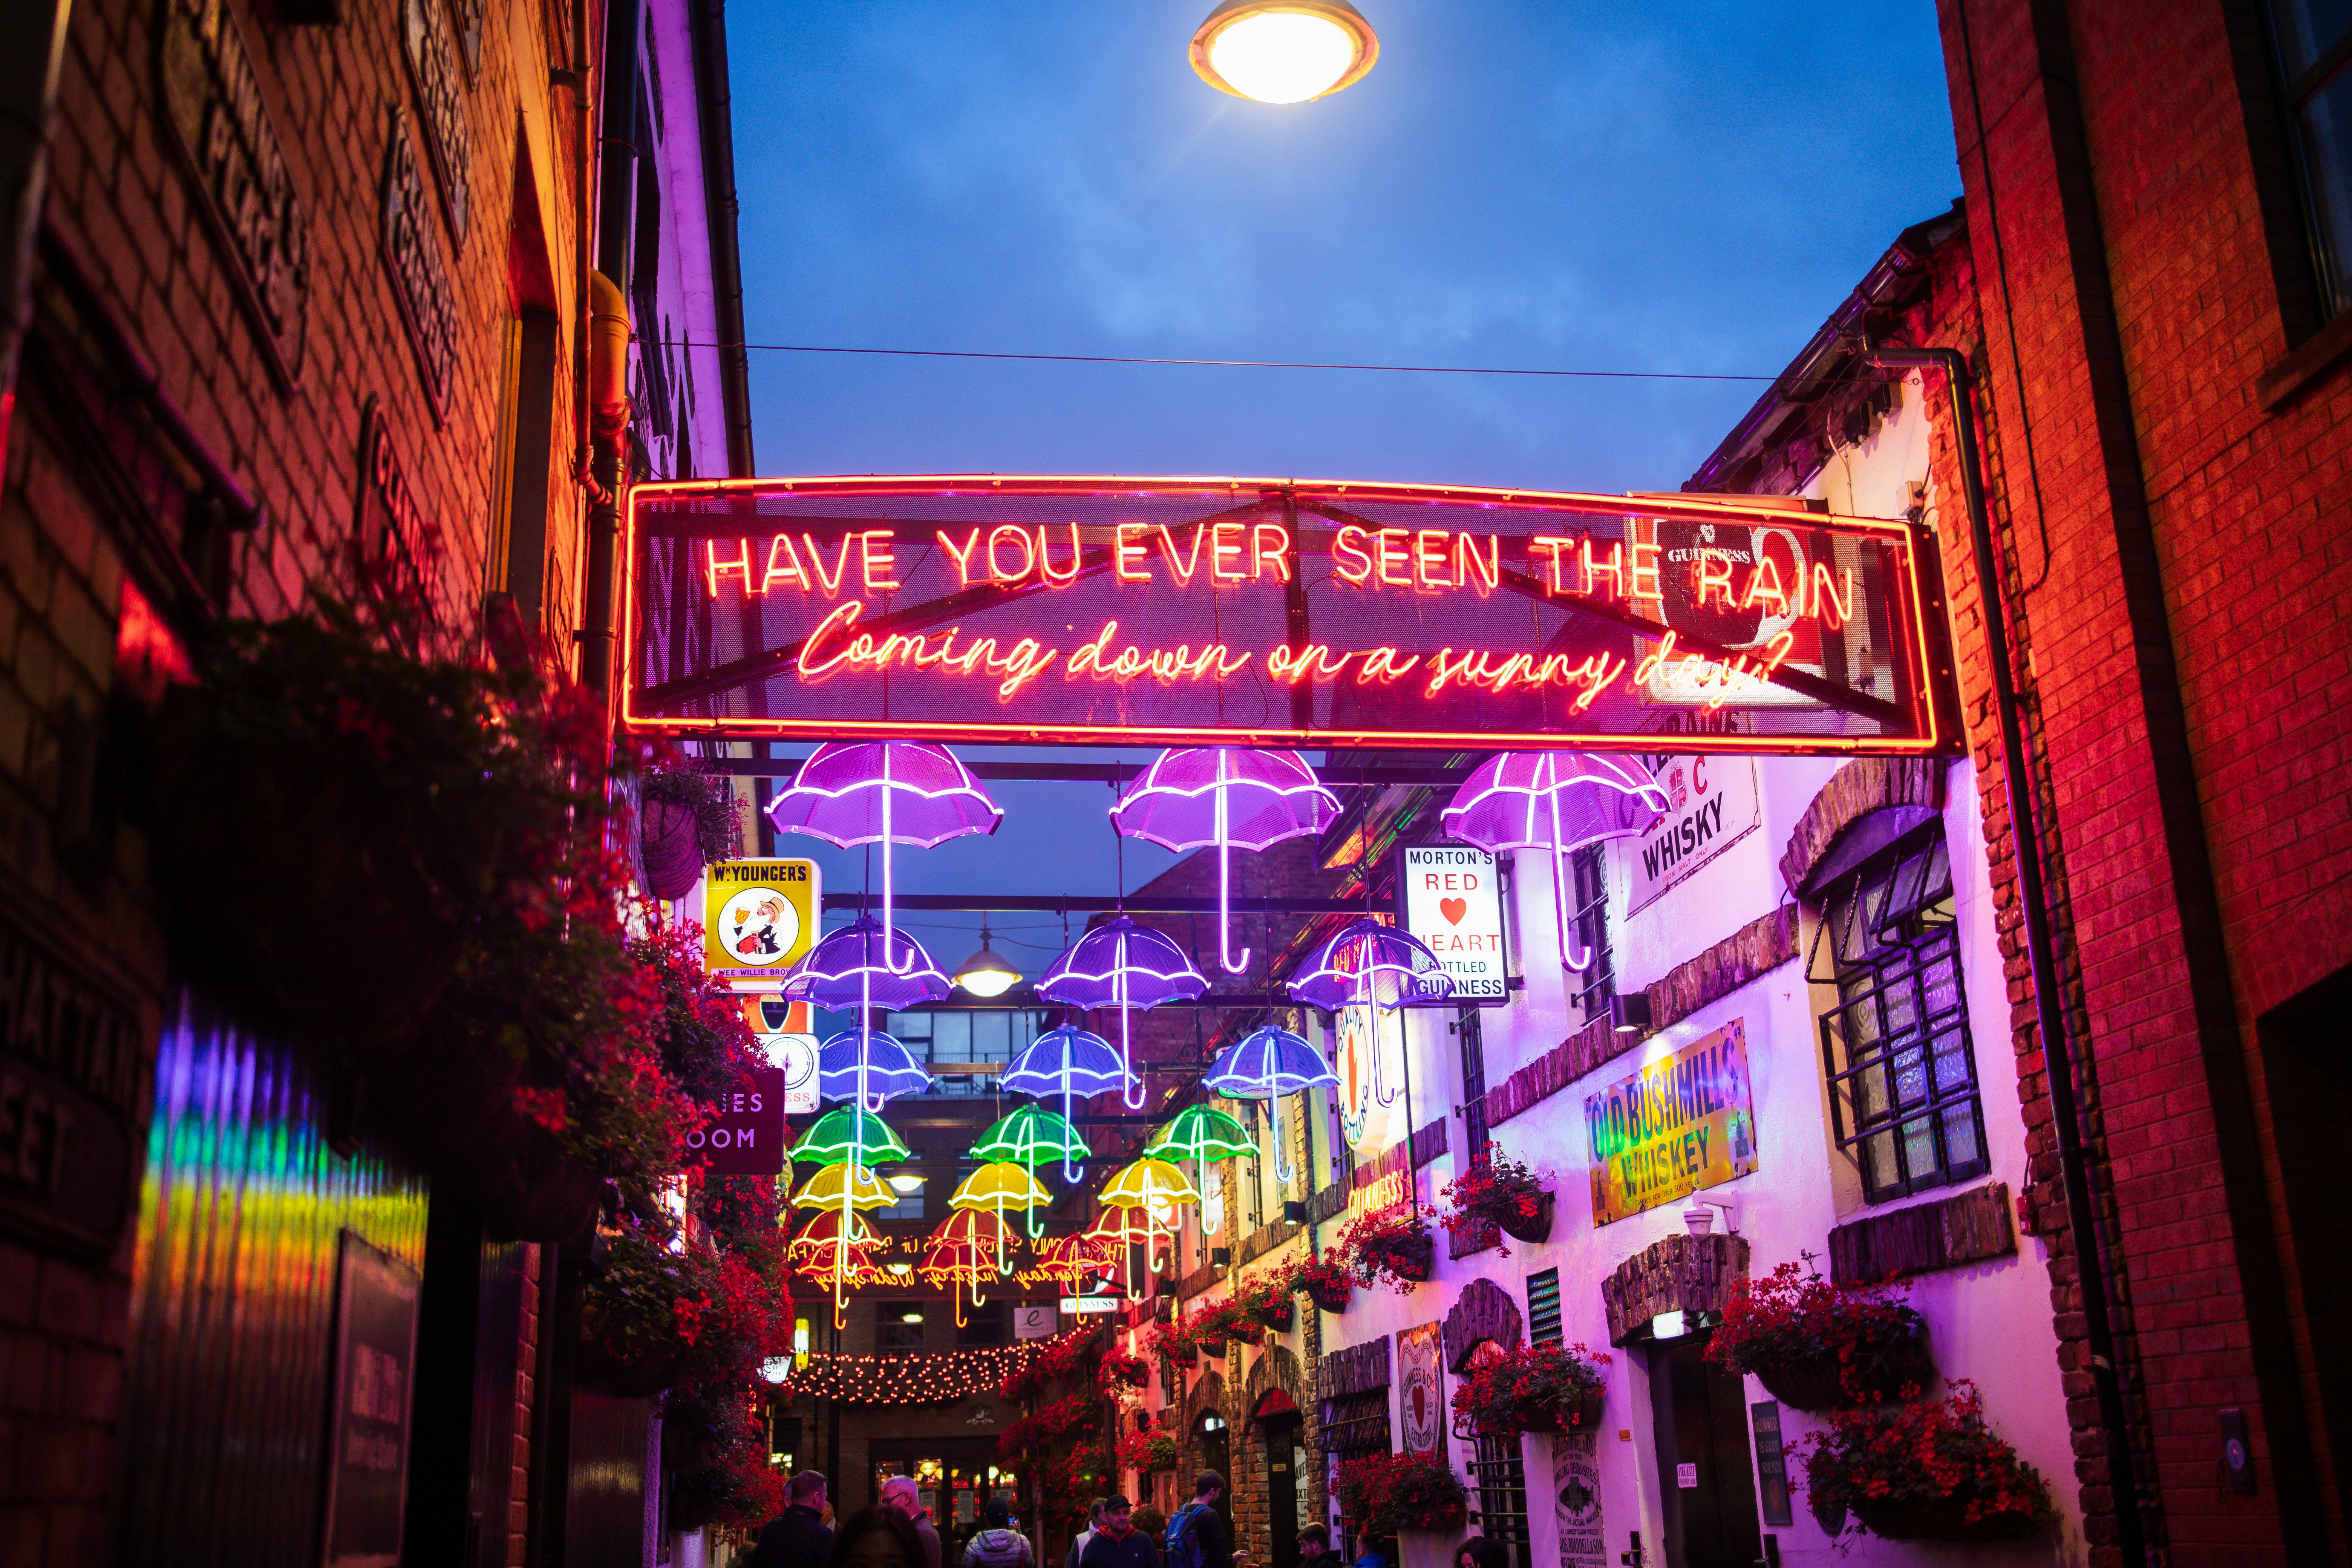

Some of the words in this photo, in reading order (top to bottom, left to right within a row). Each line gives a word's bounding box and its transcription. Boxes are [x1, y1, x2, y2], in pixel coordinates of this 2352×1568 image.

[1668, 547, 1751, 564] GUINNESS
[708, 529, 901, 597] HAVE
[937, 522, 1081, 584] YOU
[1117, 522, 1291, 583] EVER
[1335, 524, 1499, 588] SEEN
[1533, 535, 1664, 600] THE
[1699, 548, 1853, 620] RAIN
[798, 600, 1057, 695] Coming
[1068, 621, 1251, 678] down
[1267, 643, 1351, 683] on
[1362, 644, 1416, 677] a
[1430, 646, 1627, 710] sunny
[1634, 630, 1793, 707] day?
[1642, 790, 1723, 882] WHISKY
[1410, 851, 1493, 865] MORTON'S
[1426, 873, 1478, 890] RED
[1662, 870, 1675, 884] FROM
[1678, 858, 1691, 872] MALT
[1338, 1006, 1363, 1053] QUALITY
[1340, 1084, 1368, 1141] BOTTLING
[686, 1129, 754, 1148] OOM
[1621, 1124, 1709, 1198] WHISKEY
[1348, 1170, 1403, 1219] GUINNESS
[1635, 1196, 1651, 1206] FAMOUS
[1662, 1188, 1672, 1197] OVER
[1674, 1183, 1683, 1193] 300
[1574, 1438, 1593, 1458] IRELAND
[1765, 1439, 1779, 1453] GOOD
[1554, 1463, 1569, 1485] ANGLING
[1570, 1462, 1597, 1485] REQUISITES
[1686, 1465, 1695, 1476] EXIT
[1762, 1461, 1771, 1474] FOR
[1771, 1460, 1782, 1473] YOU
[1573, 1518, 1585, 1527] ACTUAL
[1568, 1537, 1590, 1554] BRADDELL
[1593, 1539, 1604, 1555] SON
